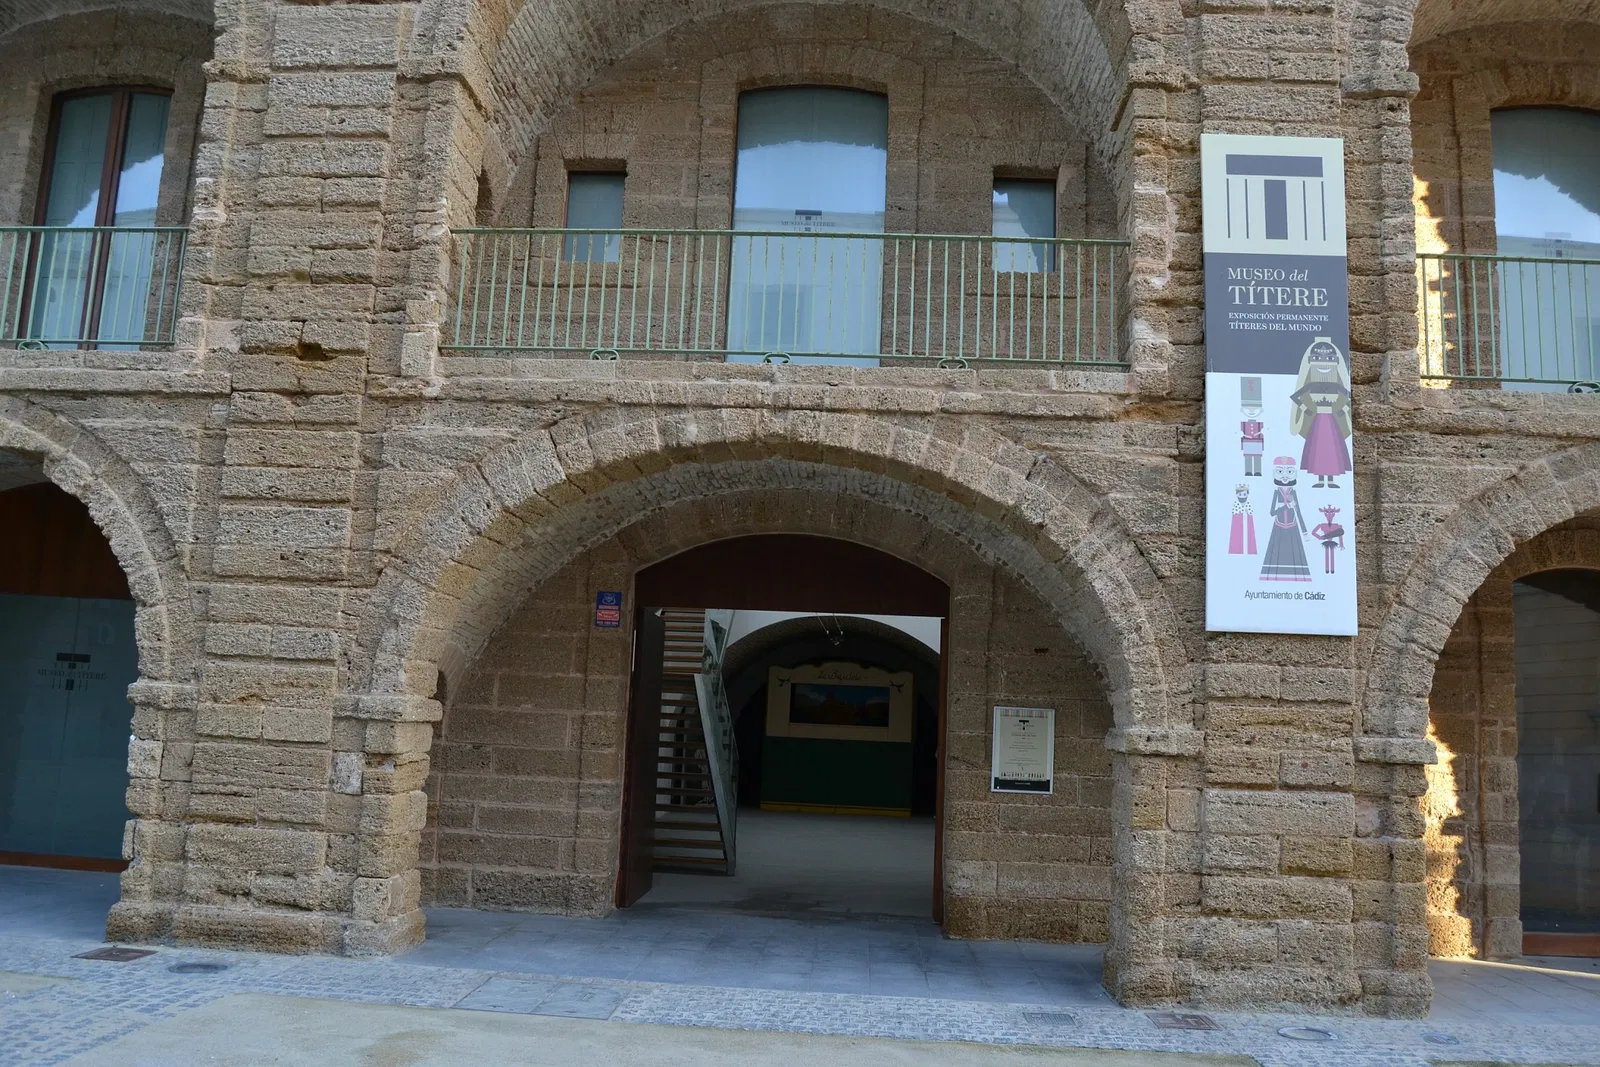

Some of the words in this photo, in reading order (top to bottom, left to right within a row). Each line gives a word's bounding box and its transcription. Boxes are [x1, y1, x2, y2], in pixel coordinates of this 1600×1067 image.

[1228, 268, 1285, 281] MUSEO
[1289, 269, 1308, 282] del
[1228, 281, 1328, 307] TÍTERE
[1228, 311, 1275, 321] EXPOSICIÓN
[1276, 313, 1329, 322] PERMANENTE
[1229, 321, 1268, 331] TÍTERES
[1269, 322, 1287, 331] DEL
[1288, 323, 1322, 332] MUNDO
[1244, 590, 1293, 600] Ayuntamiento
[1294, 591, 1304, 600] de
[1304, 591, 1326, 600] Cádiz
